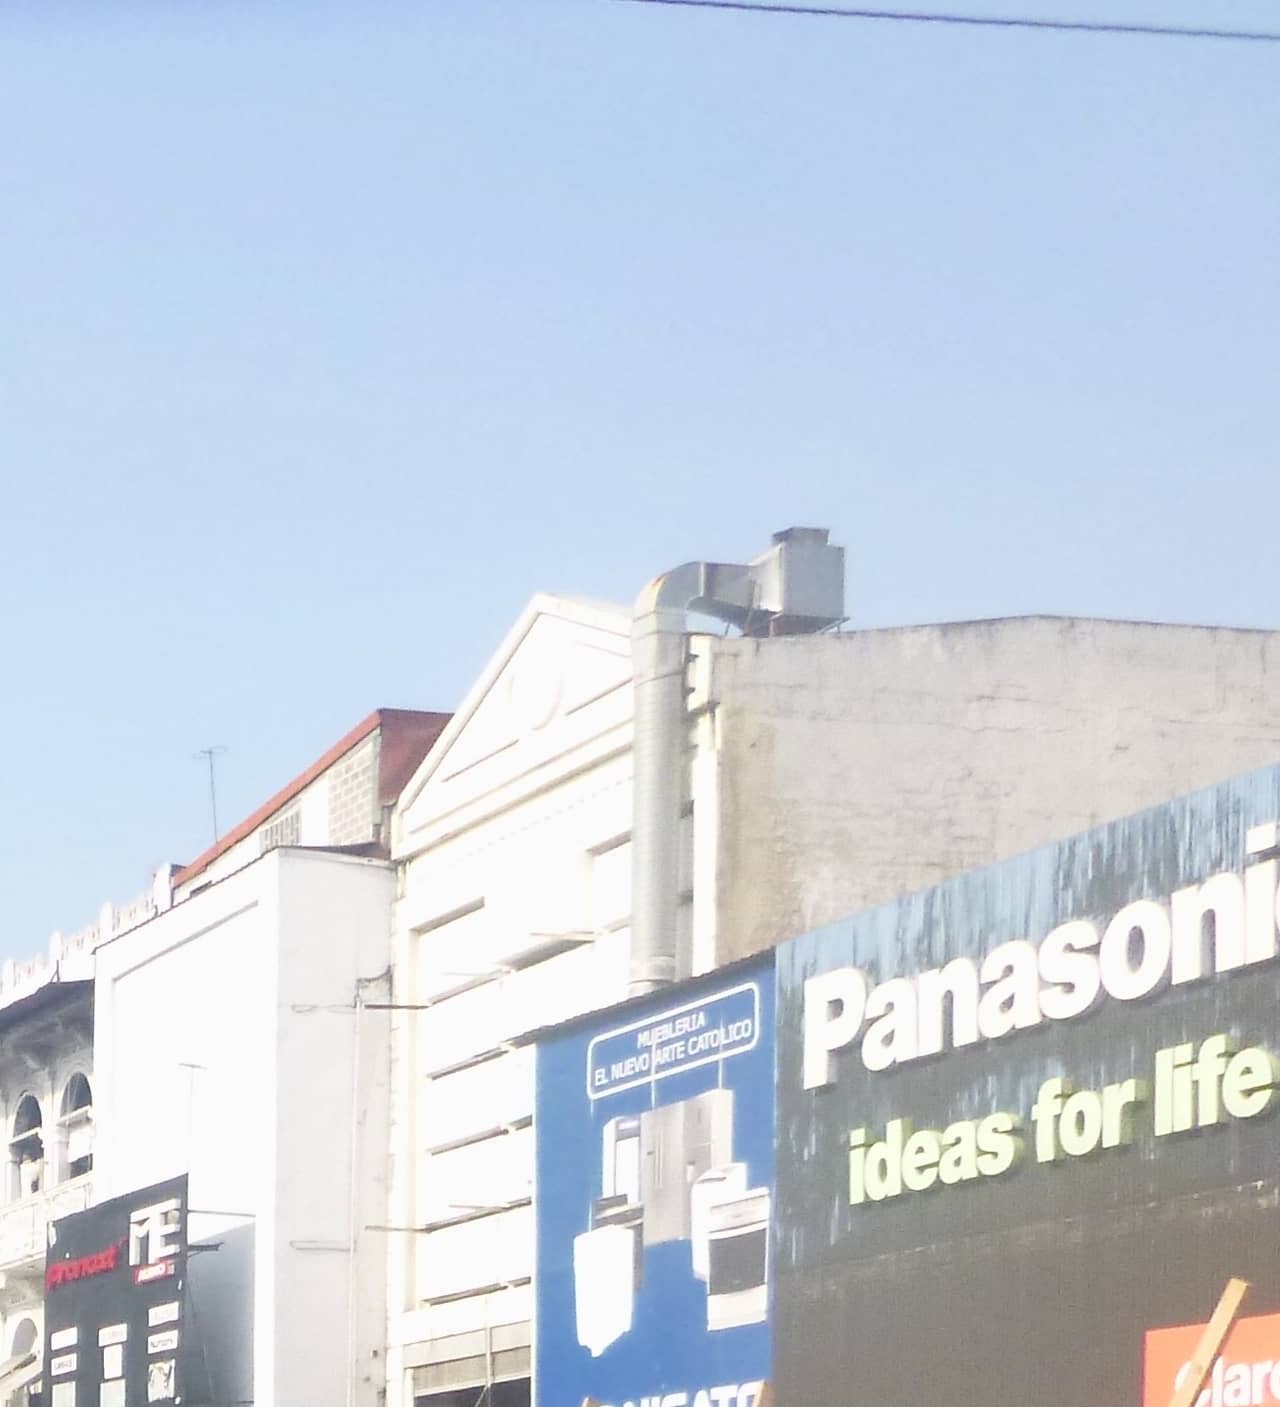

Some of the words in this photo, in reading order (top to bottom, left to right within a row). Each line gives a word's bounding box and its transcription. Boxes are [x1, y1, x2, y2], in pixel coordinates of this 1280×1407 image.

[804, 823, 1280, 1089] Panasoni
[595, 1068, 609, 1086] EL
[611, 1055, 648, 1080] NUEVO
[655, 1042, 686, 1065] ARTE
[688, 1019, 752, 1055] CATOLICO
[637, 1012, 706, 1048] MUEBLERIA
[849, 1112, 1018, 1204] ideas
[1032, 1078, 1140, 1162] for
[1154, 1034, 1276, 1137] life
